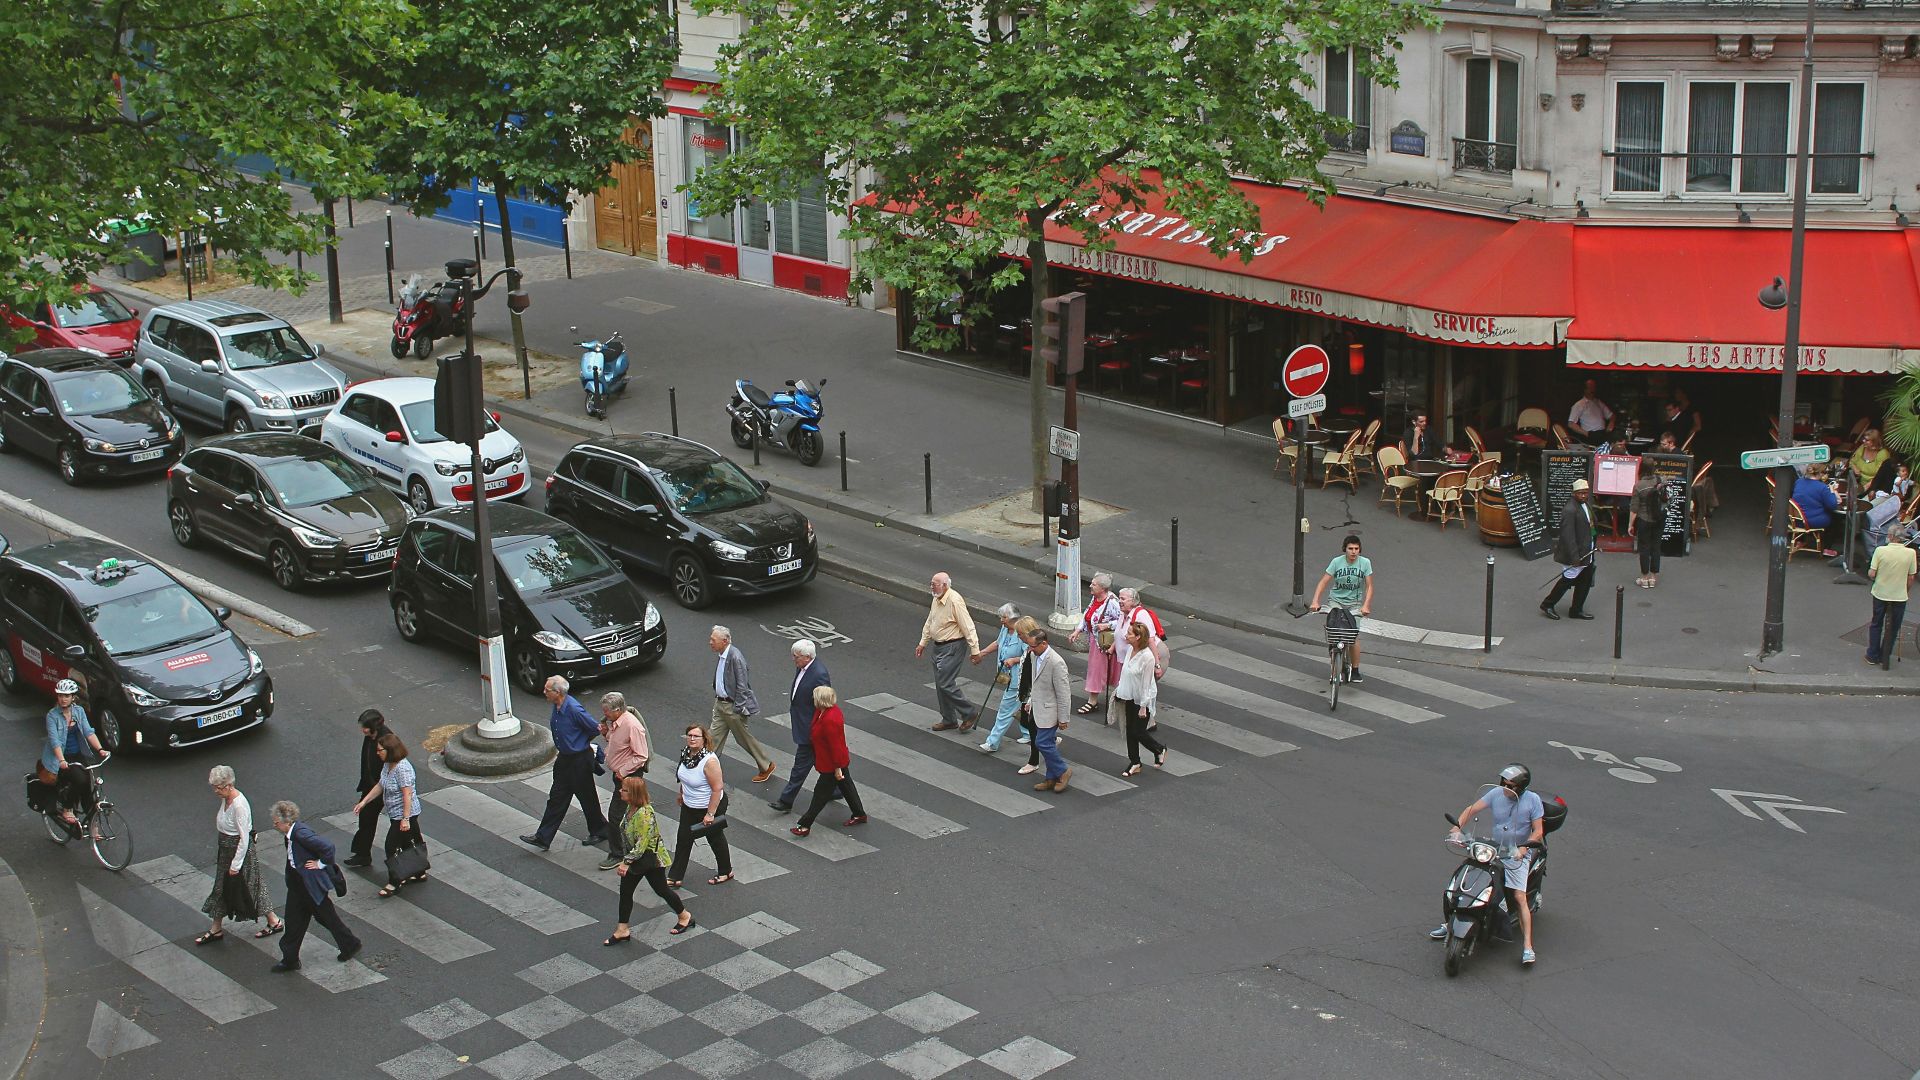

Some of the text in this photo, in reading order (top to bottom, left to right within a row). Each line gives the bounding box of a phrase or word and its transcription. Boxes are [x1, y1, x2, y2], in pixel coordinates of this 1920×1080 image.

[1071, 247, 1157, 277] LES ARTISANS
[1290, 288, 1323, 306] RESTO
[1433, 312, 1496, 334] SERVICE
[1476, 325, 1518, 340] Continu
[1687, 345, 1826, 366] LES ARTISNS
[1291, 399, 1324, 413] SAUF CYCLISTES
[1335, 567, 1366, 578] FRANKLIN
[1346, 576, 1352, 584] &
[167, 653, 208, 667] ALLO RESTO
[605, 655, 613, 663] 61
[630, 647, 638, 656] 75
